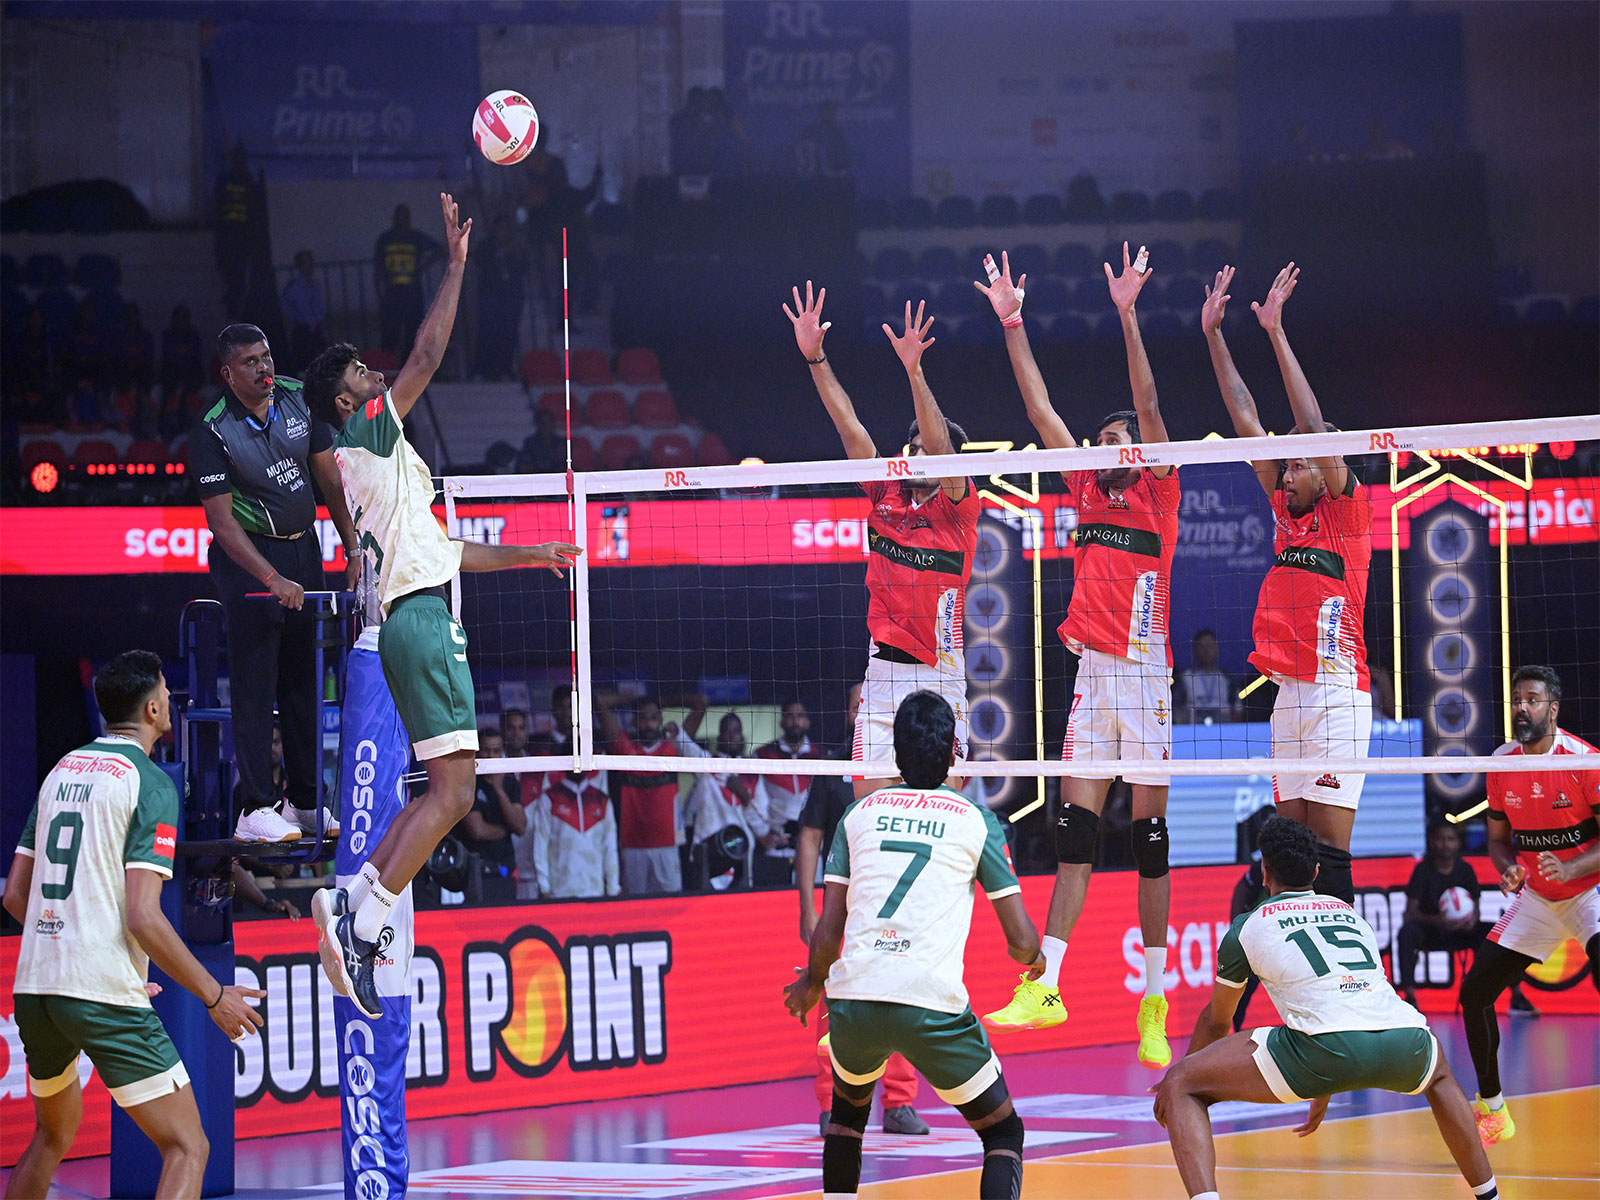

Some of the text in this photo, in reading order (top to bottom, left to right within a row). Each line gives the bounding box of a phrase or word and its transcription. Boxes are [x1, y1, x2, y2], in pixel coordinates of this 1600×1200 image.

[273, 104, 377, 138] Prime
[1369, 432, 1399, 450] RR
[1118, 447, 1146, 464] RR
[664, 470, 689, 487] RR
[886, 460, 912, 477] RR
[1181, 490, 1225, 515] RR
[1076, 530, 1130, 545] HANGALS
[1138, 575, 1154, 638] travlounge
[943, 592, 954, 653] travlounge
[1324, 600, 1341, 660] travlounge
[56, 782, 93, 802] NITIN
[862, 793, 971, 816] Krispy Kreme
[876, 816, 946, 839] SETHU
[1520, 830, 1581, 846] THANGALS
[41, 811, 84, 900] 9
[877, 840, 932, 919] 7
[881, 929, 897, 939] RR
[1285, 925, 1377, 978] 15
